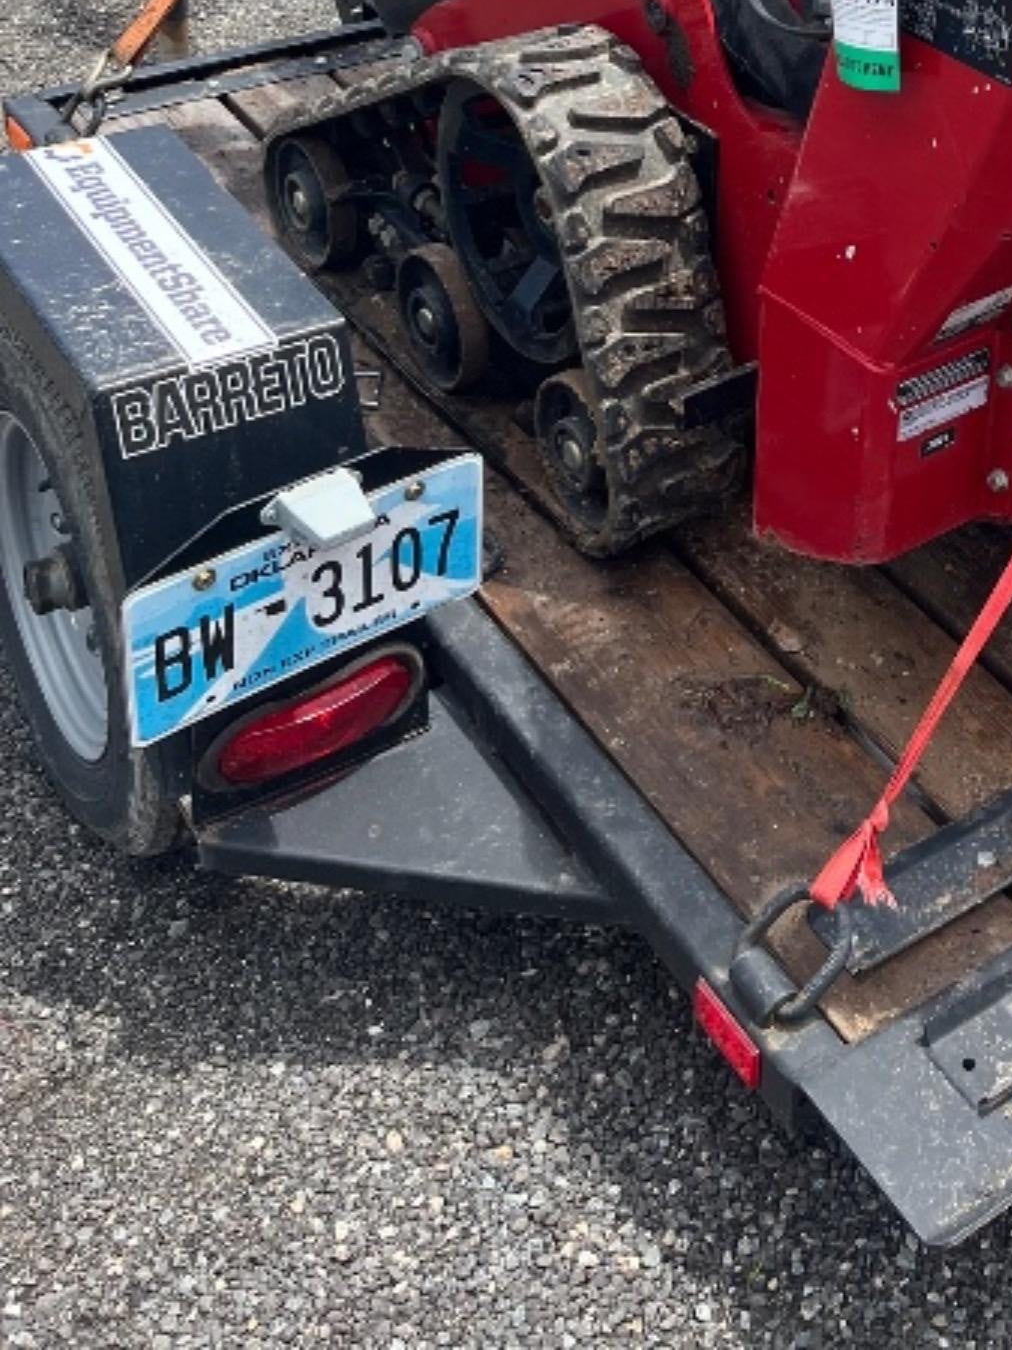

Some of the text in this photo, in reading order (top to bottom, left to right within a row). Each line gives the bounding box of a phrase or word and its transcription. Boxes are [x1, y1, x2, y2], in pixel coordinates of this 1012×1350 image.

[64, 161, 232, 346] EquipmentShare
[111, 333, 347, 460] BARRETO
[154, 508, 460, 703] BW 3107
